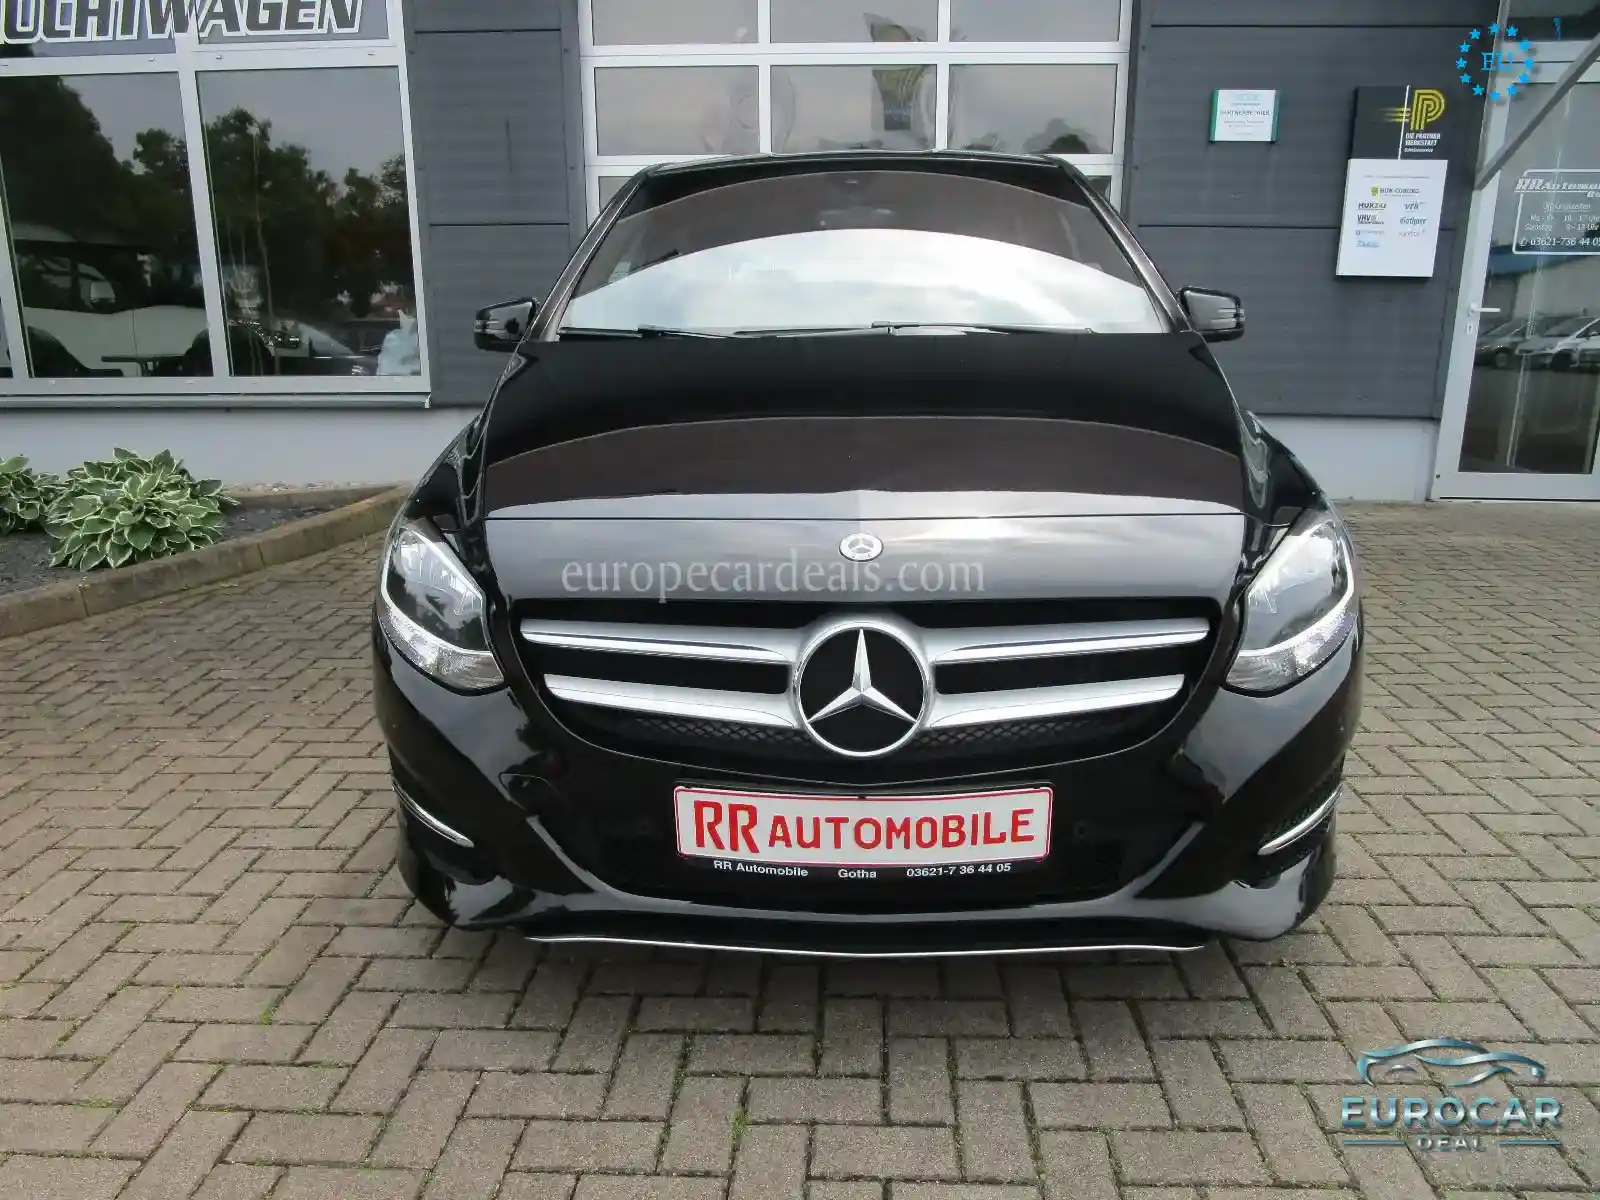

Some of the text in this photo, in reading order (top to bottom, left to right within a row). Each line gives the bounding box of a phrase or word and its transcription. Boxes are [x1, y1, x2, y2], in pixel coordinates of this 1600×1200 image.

[694, 800, 1035, 853] RR AUTOMOBILE
[713, 860, 1012, 878] RR Automobile Gotha 03621-7 36 44 05
